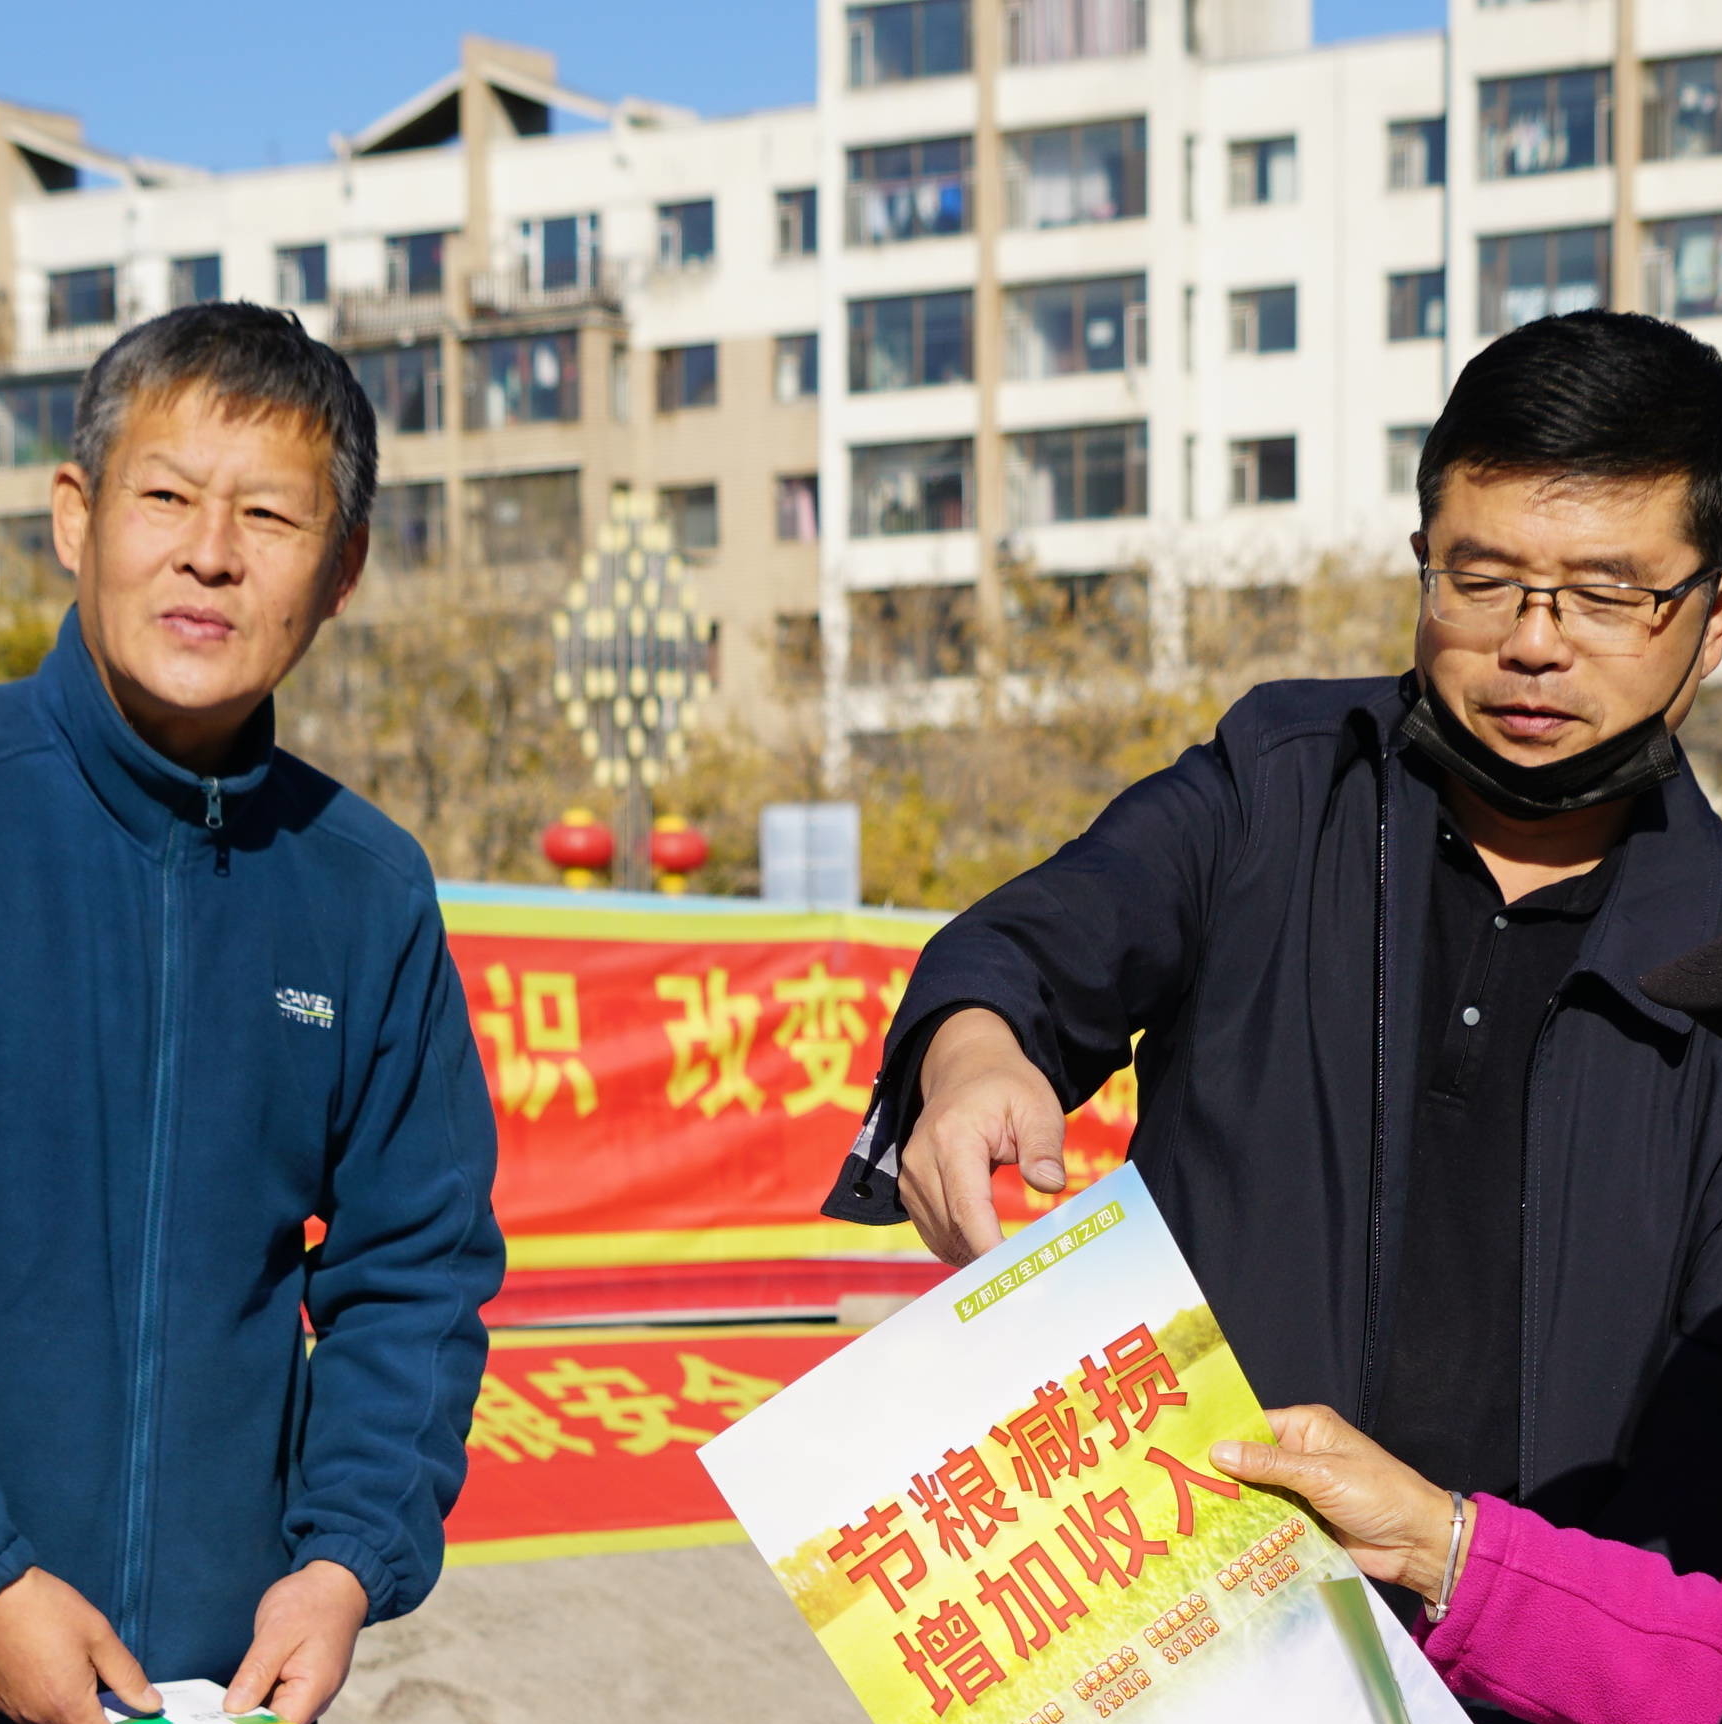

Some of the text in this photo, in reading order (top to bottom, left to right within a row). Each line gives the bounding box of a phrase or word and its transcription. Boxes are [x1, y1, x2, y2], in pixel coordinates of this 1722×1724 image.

[655, 962, 907, 1119] 改变
[827, 1322, 1188, 1615] 节粮减损
[892, 1446, 1241, 1717] 增加收入
